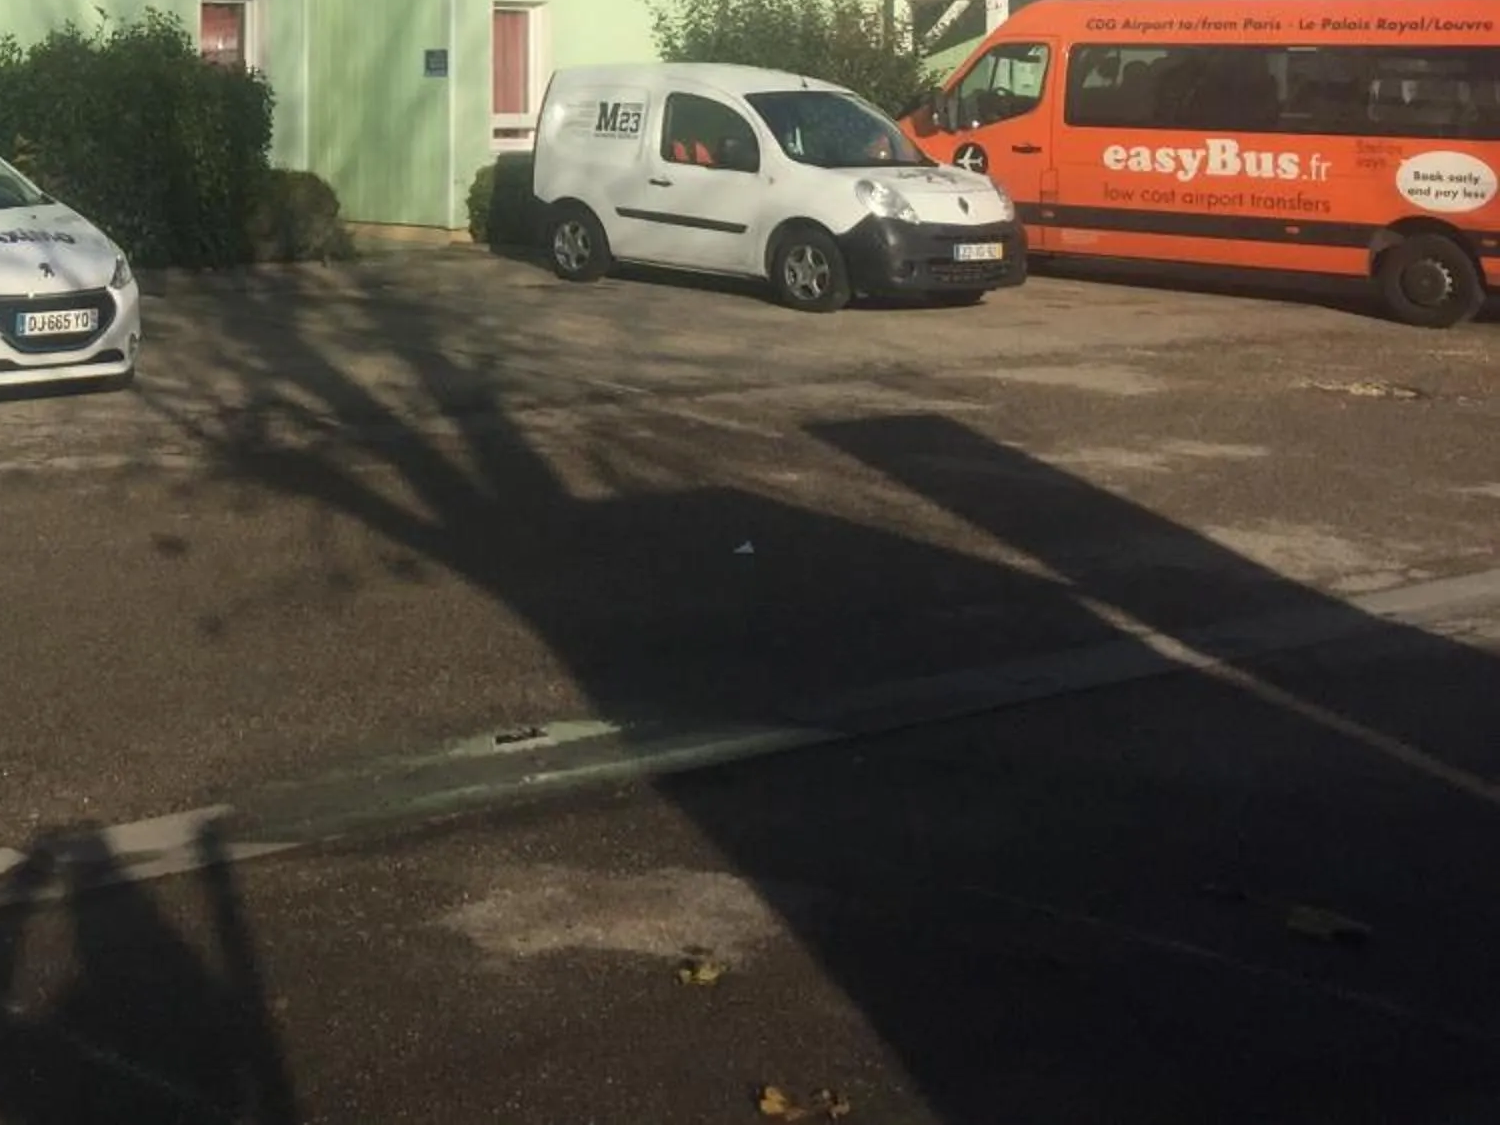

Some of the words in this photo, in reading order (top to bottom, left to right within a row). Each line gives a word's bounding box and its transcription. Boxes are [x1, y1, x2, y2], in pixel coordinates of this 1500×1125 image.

[1086, 17, 1117, 31] CDG
[1121, 17, 1175, 35] Airport
[1242, 17, 1282, 31] Paris
[1299, 18, 1317, 31] Le
[1321, 16, 1372, 31] Palais
[595, 101, 642, 133] M23
[1102, 138, 1332, 182] easyBus.fr
[1412, 170, 1445, 182] Book
[1103, 181, 1134, 203] low
[1140, 188, 1176, 205] cost
[1181, 190, 1244, 211] airport
[1250, 191, 1332, 214] transfers
[1407, 186, 1432, 197] and
